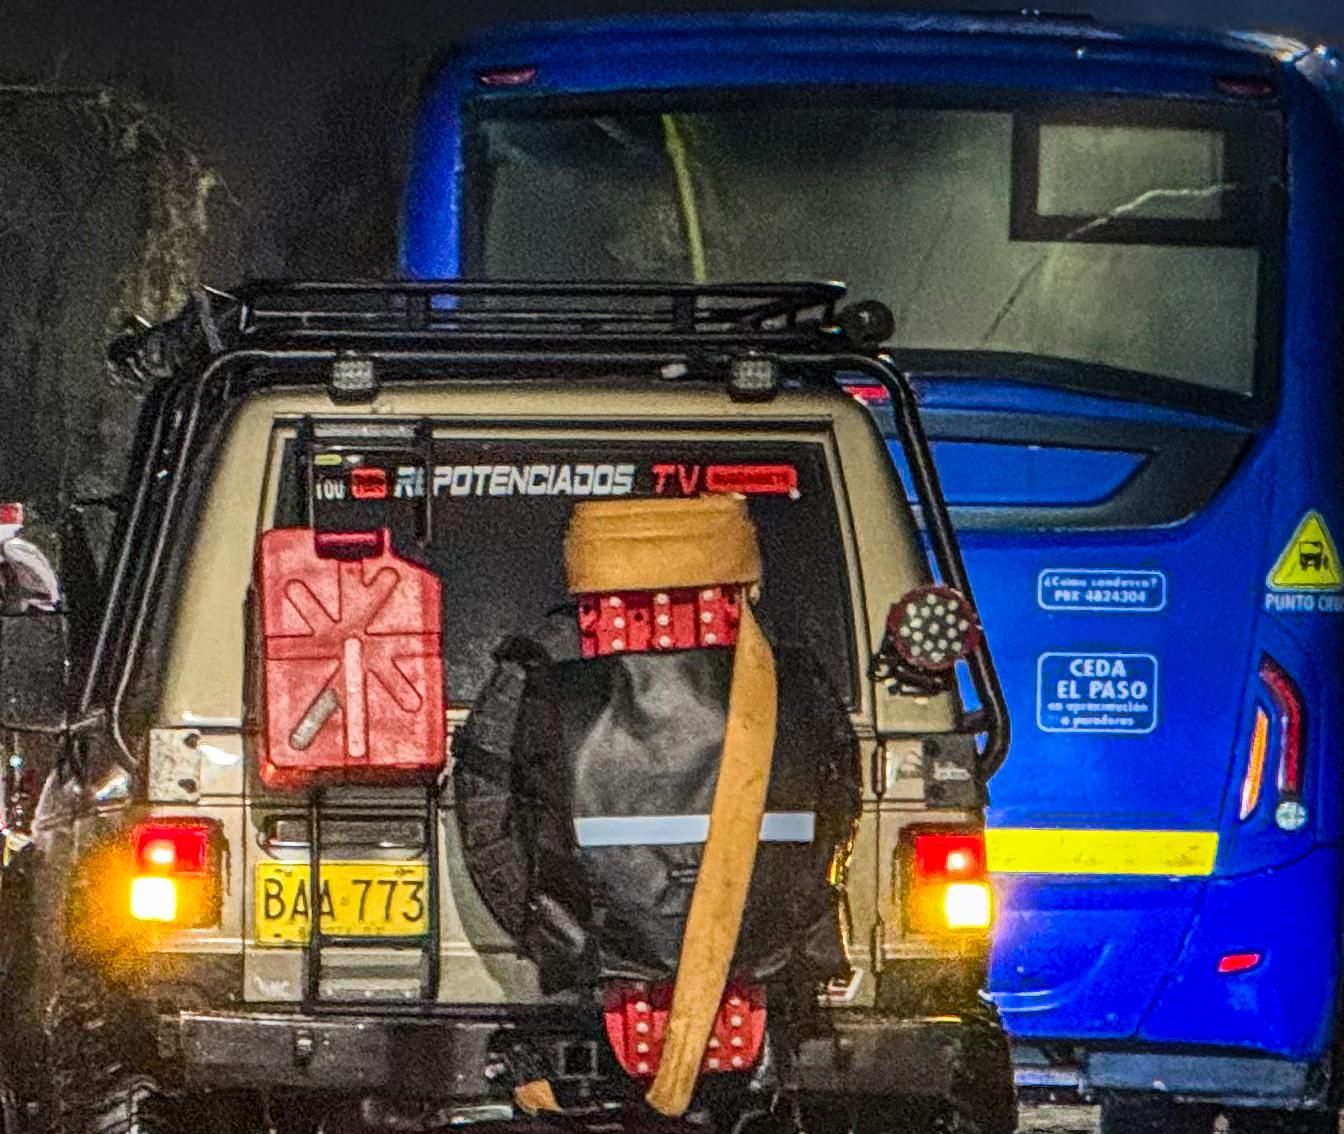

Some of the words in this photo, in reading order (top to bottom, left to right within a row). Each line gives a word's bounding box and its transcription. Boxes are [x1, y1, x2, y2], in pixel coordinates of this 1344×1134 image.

[652, 464, 700, 495] TV
[1265, 594, 1314, 611] PUNTO
[1069, 659, 1127, 677] CEDA
[1057, 681, 1081, 699] EL
[1089, 681, 1148, 699] PASO
[264, 878, 336, 921] BAA
[352, 879, 425, 923] 773
